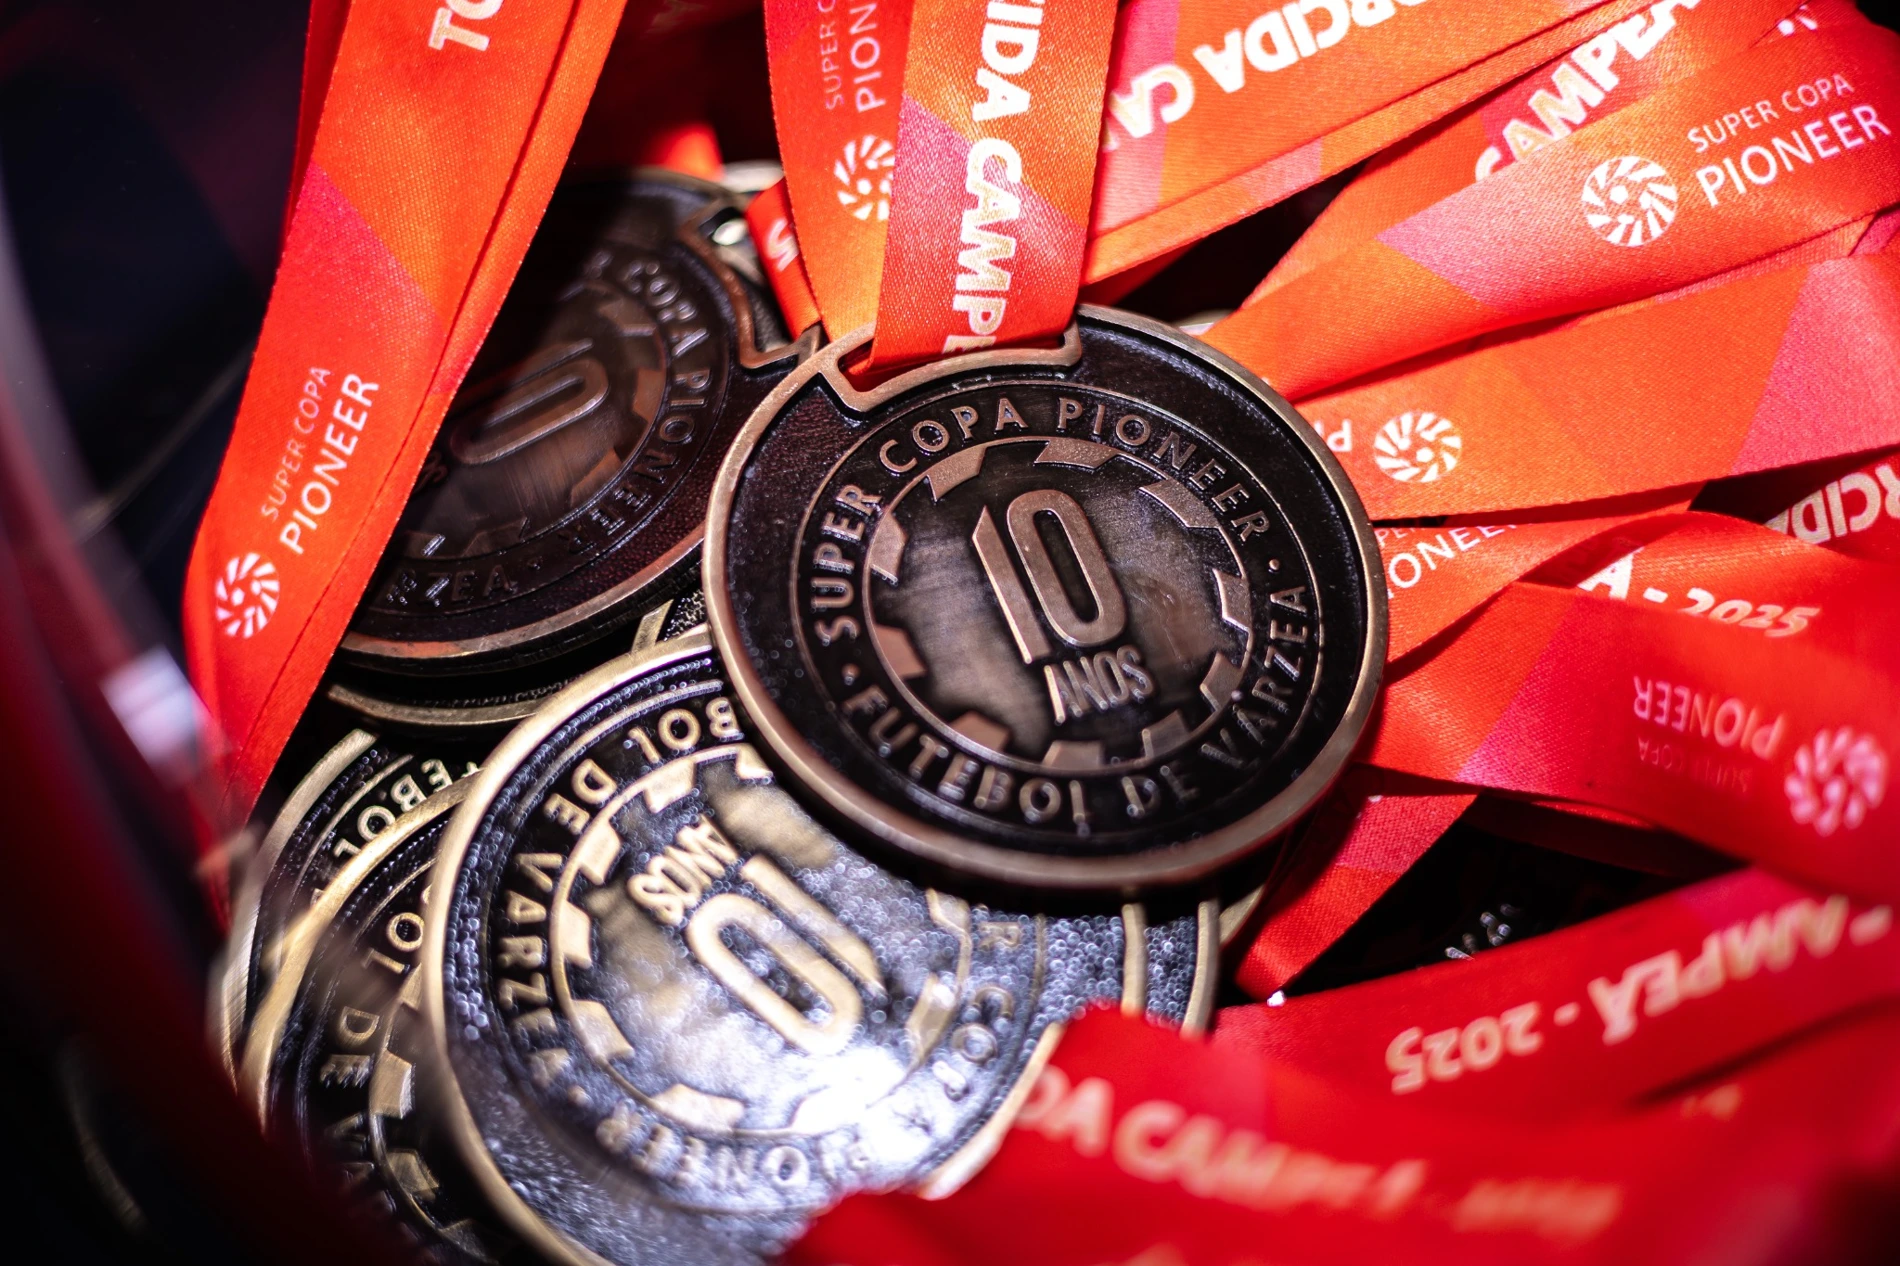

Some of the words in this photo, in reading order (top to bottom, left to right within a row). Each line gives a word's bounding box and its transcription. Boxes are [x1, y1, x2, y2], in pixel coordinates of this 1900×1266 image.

[820, 22, 845, 110] SUPER
[1687, 98, 1779, 154] SUPER
[1782, 72, 1855, 114] COPA
[1695, 105, 1891, 209] PIONEER
[261, 438, 306, 522] SUPER
[294, 366, 332, 434] COPA
[279, 373, 380, 555] PIONEER
[811, 484, 883, 647] SUPER
[878, 397, 1029, 475] COPA
[1056, 397, 1271, 544] PIONEER
[972, 489, 1128, 665] 10
[1680, 587, 1821, 639] 2025
[1044, 645, 1155, 725] ANOS
[1633, 675, 1785, 761] PIONEER
[543, 758, 618, 836] DE
[841, 684, 1093, 838] FUTEBOL
[1120, 759, 1199, 819] DE
[627, 814, 742, 927] ANOS
[686, 853, 887, 1057] 10
[1385, 1001, 1544, 1095] 2025
